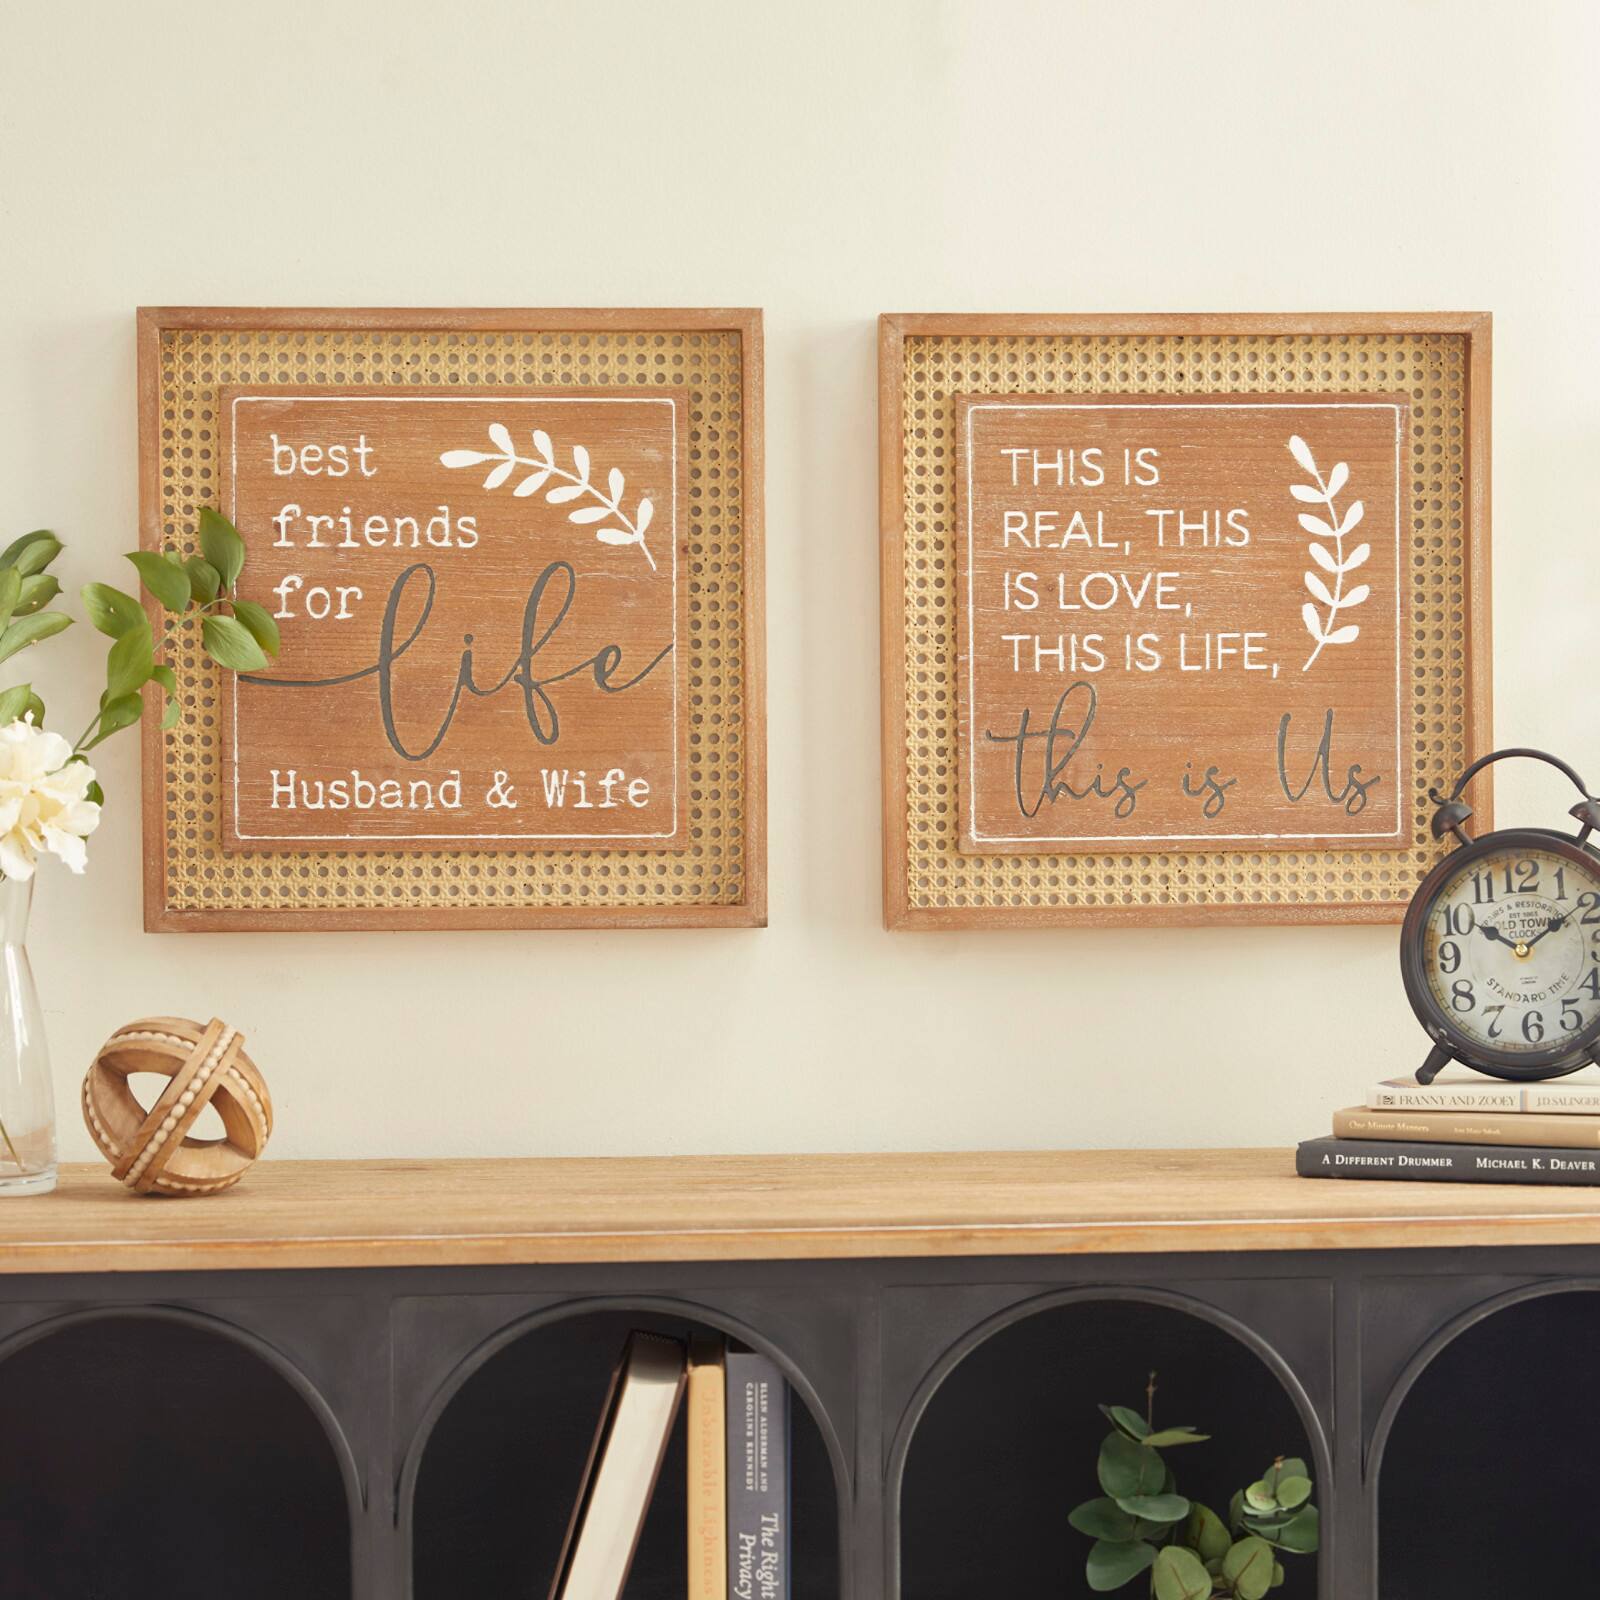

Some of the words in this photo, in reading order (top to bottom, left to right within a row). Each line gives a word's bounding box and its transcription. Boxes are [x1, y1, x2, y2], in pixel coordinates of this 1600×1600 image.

[270, 434, 377, 477] best
[1000, 448, 1105, 486] THIS
[1125, 448, 1160, 486] IS
[272, 504, 480, 548] friends
[1003, 510, 1131, 556] REAL,
[1145, 509, 1251, 547] THIS
[272, 575, 364, 619] for
[1003, 571, 1040, 611] IS
[1059, 571, 1193, 618] LOVE,
[238, 561, 674, 761] life
[1001, 633, 1105, 672] THIS
[1126, 633, 1161, 672] IS
[1180, 632, 1279, 680] LIFE,
[985, 680, 1148, 819] this
[1181, 761, 1238, 819] is
[1276, 708, 1381, 817] Us
[270, 769, 462, 809] Husband
[486, 769, 518, 809] &
[541, 768, 650, 809] Wife
[1471, 871, 1497, 905] 11
[1503, 859, 1541, 894] 12
[1553, 867, 1568, 900] 1
[1443, 902, 1475, 937] 10
[1438, 941, 1461, 973] 9
[1451, 979, 1476, 1013] 8
[1487, 978, 1547, 1004] STANDARD
[1548, 973, 1570, 994] TIME
[1578, 967, 1600, 1000] 4
[1481, 1005, 1505, 1038] 7
[1521, 1010, 1545, 1043] 6
[1559, 998, 1583, 1031] 5
[1399, 1095, 1447, 1105] FRANNY
[1449, 1095, 1475, 1105] AND
[1478, 1095, 1516, 1106] ZOOEY
[1348, 1120, 1366, 1129] One
[1322, 1154, 1331, 1165] A
[1335, 1154, 1395, 1166] DIFFERENT
[1398, 1155, 1453, 1167] DRUMMER
[1476, 1157, 1527, 1169] MICHAEL
[1532, 1158, 1545, 1169] K.
[1550, 1158, 1596, 1170] DEAVER
[746, 1382, 754, 1437] CAROLINE
[760, 1382, 768, 1413] ELLEN
[760, 1416, 768, 1468] ALDERMAN
[746, 1441, 754, 1492] KENNEDY
[760, 1472, 768, 1492] AND
[760, 1512, 779, 1548] The
[733, 1532, 757, 1600] Privacy
[755, 1550, 779, 1599] Right
